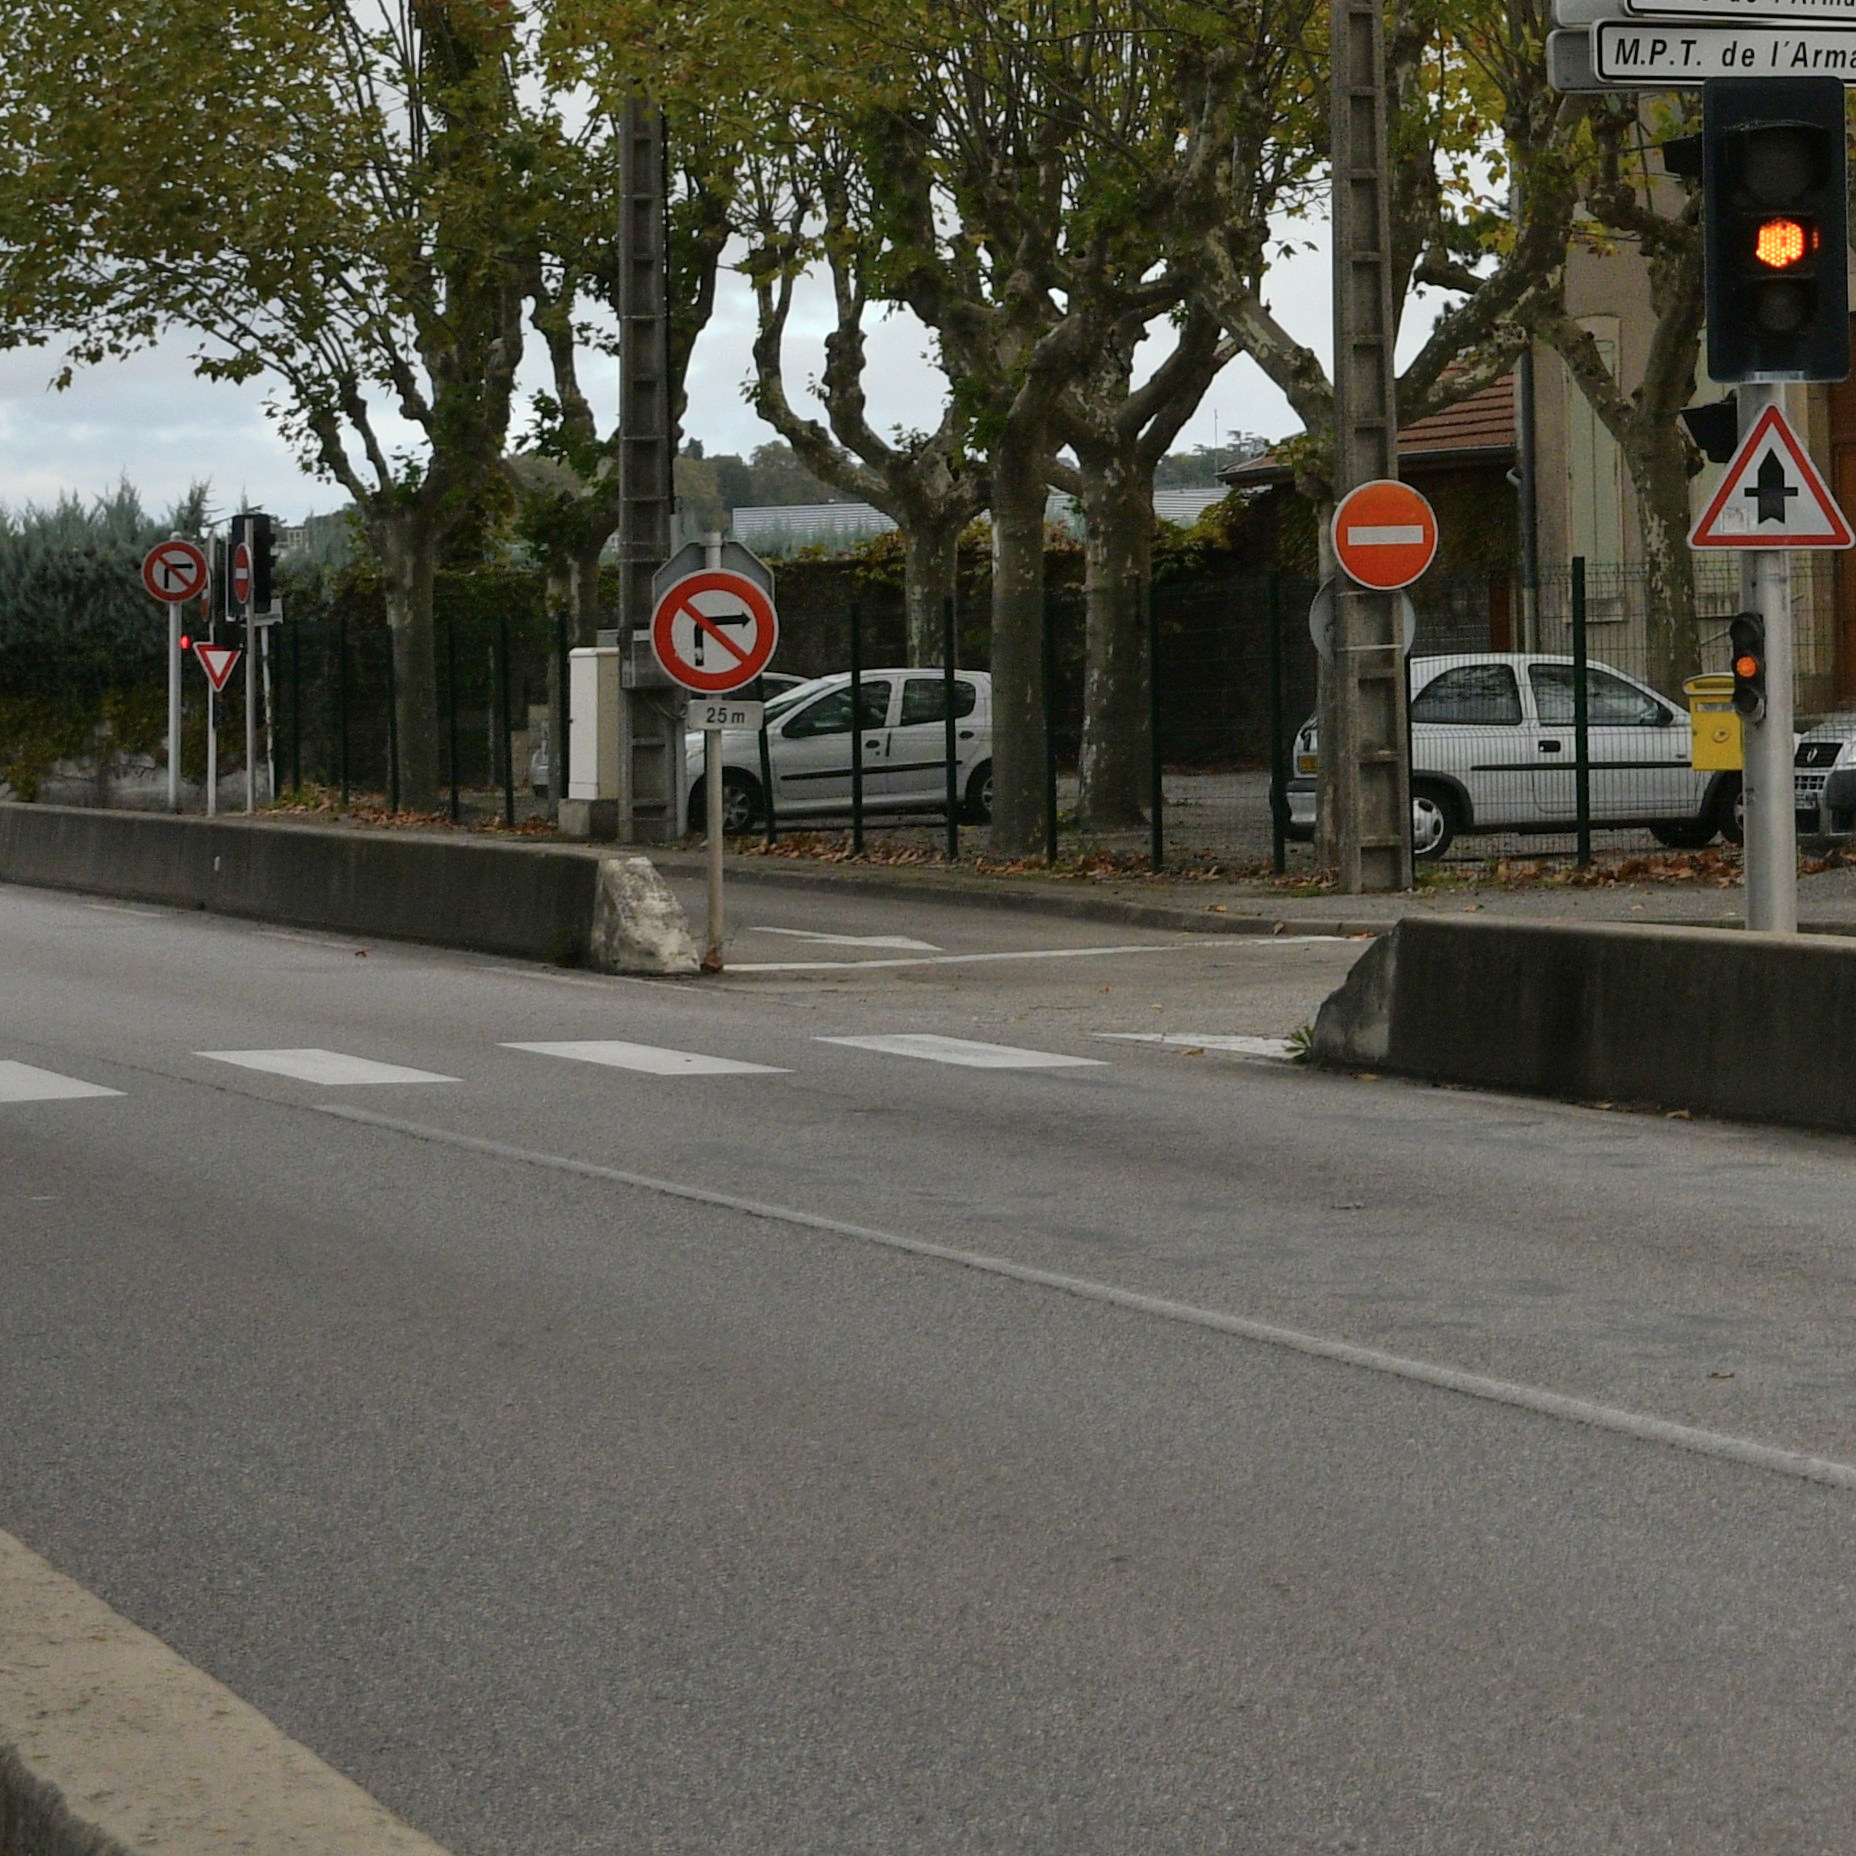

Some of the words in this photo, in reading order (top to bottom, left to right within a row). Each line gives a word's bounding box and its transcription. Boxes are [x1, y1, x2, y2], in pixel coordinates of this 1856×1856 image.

[1614, 38, 1702, 67] M.P.T.
[1721, 41, 1755, 68] de
[706, 707, 727, 723] 25
[731, 712, 745, 723] m
